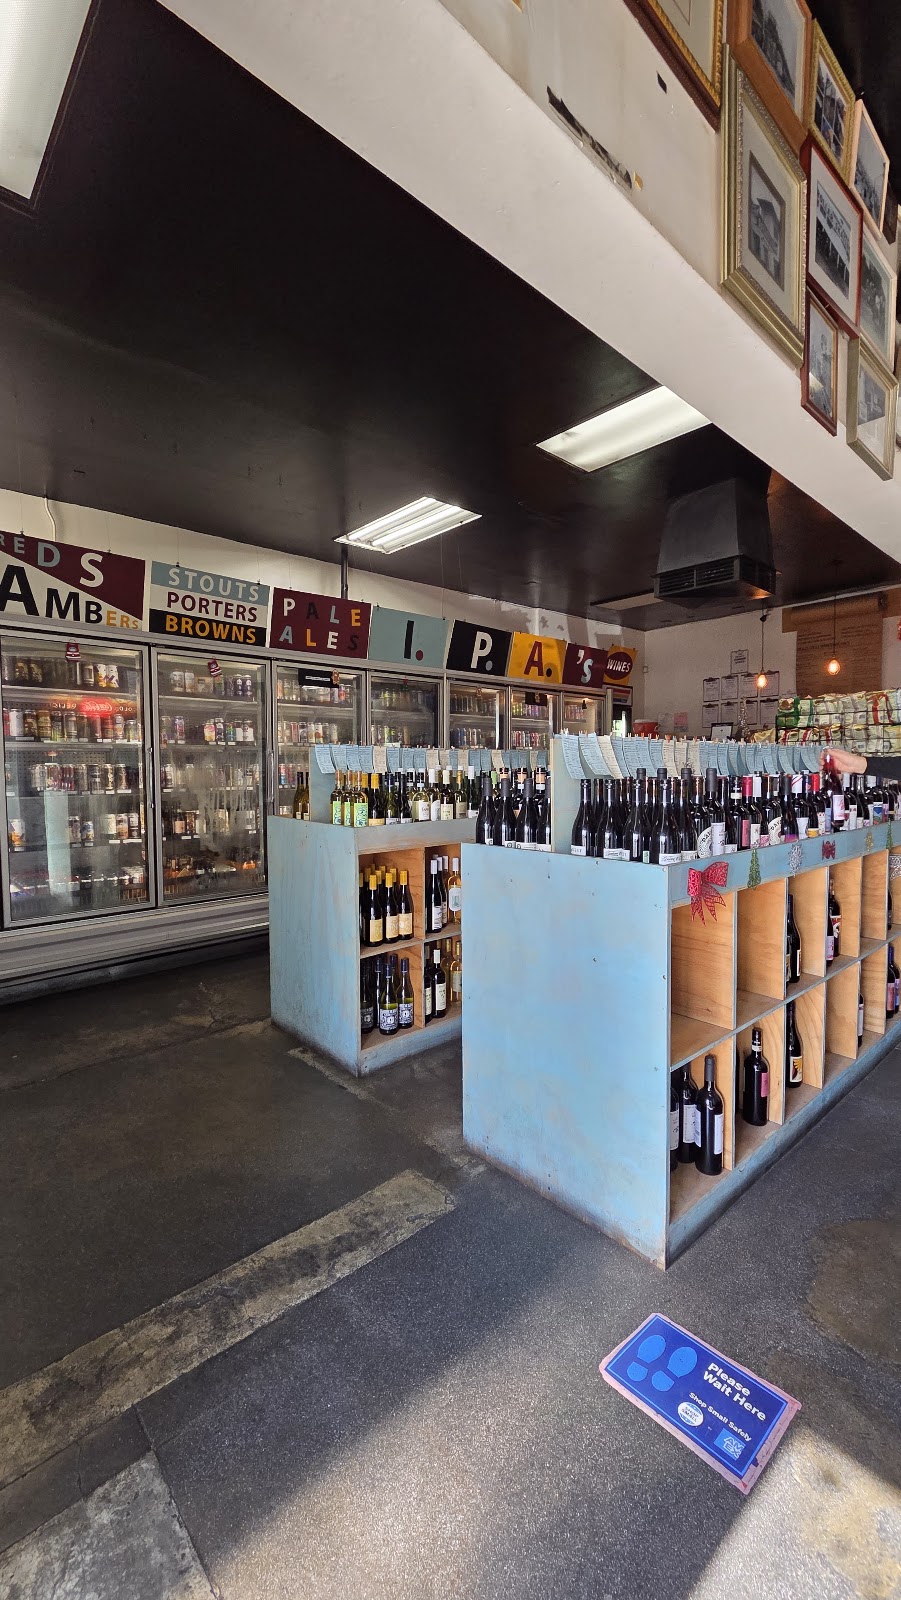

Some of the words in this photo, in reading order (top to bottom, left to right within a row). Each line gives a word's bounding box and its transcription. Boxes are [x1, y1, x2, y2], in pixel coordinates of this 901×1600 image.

[168, 567, 259, 602] STOUTS
[167, 591, 258, 623] PORTERS
[283, 598, 361, 627] PALE
[165, 614, 256, 644] BROWNS
[279, 625, 360, 651] ALES
[606, 658, 631, 673] WINES
[707, 1362, 751, 1397] Please
[703, 1371, 733, 1397] Wait
[732, 1393, 767, 1421] Here
[689, 1392, 707, 1408] Shop
[707, 1405, 729, 1424] Small
[728, 1421, 752, 1442] Safely
